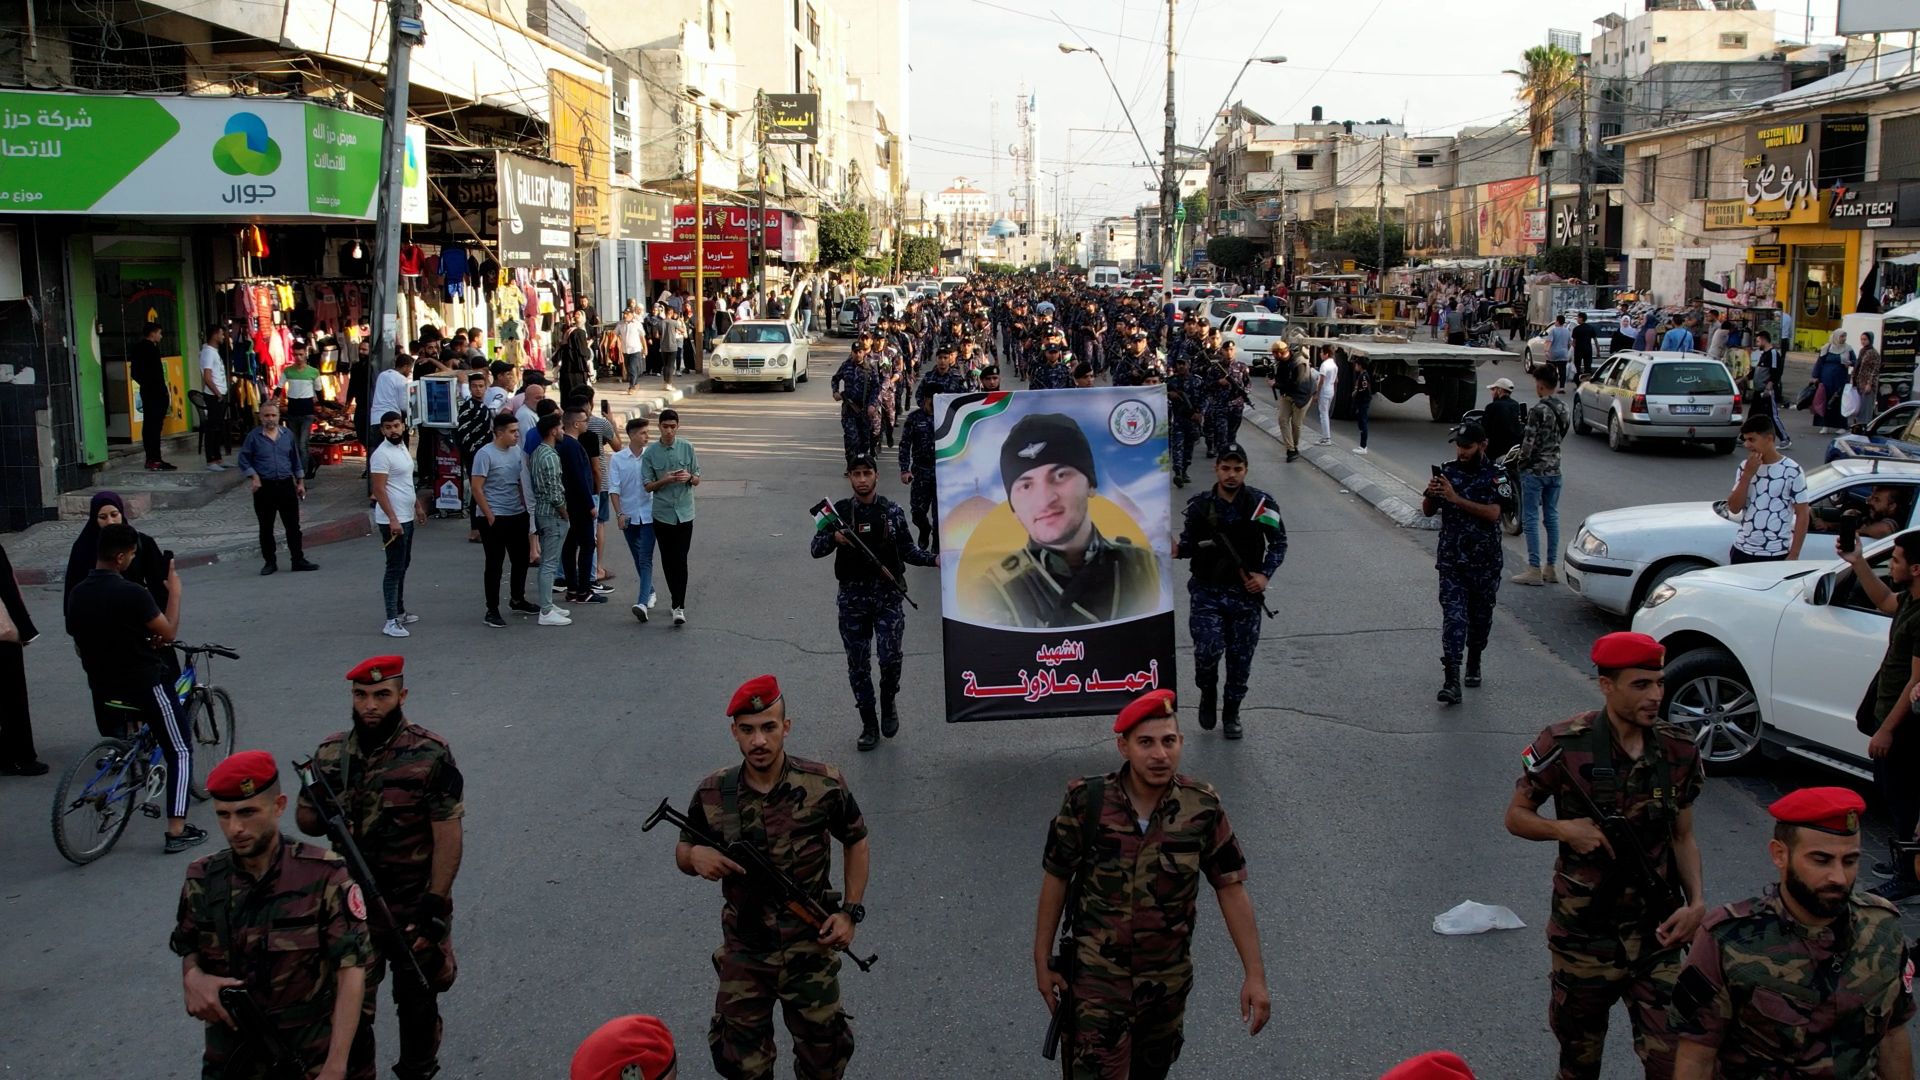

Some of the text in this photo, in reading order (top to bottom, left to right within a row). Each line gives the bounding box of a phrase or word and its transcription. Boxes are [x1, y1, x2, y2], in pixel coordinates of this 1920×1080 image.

[3, 107, 93, 131] شركة حرز
[313, 122, 357, 147] معرض حرز الله
[1758, 127, 1784, 139] WESTERN
[1765, 137, 1784, 148] UNION
[1, 139, 62, 157] للاتصا
[314, 153, 346, 171] للاتصالات
[12, 189, 43, 203] موزع
[222, 184, 276, 204] جوال
[458, 183, 497, 202] SHO
[517, 169, 549, 207] GALLERY
[550, 176, 571, 211] SHOES
[1707, 204, 1736, 215] WESTERN
[730, 212, 779, 231] شورما
[1715, 214, 1735, 225] UNION
[1036, 639, 1085, 666] الشهيد
[962, 659, 1159, 703] أحمد علاونة
